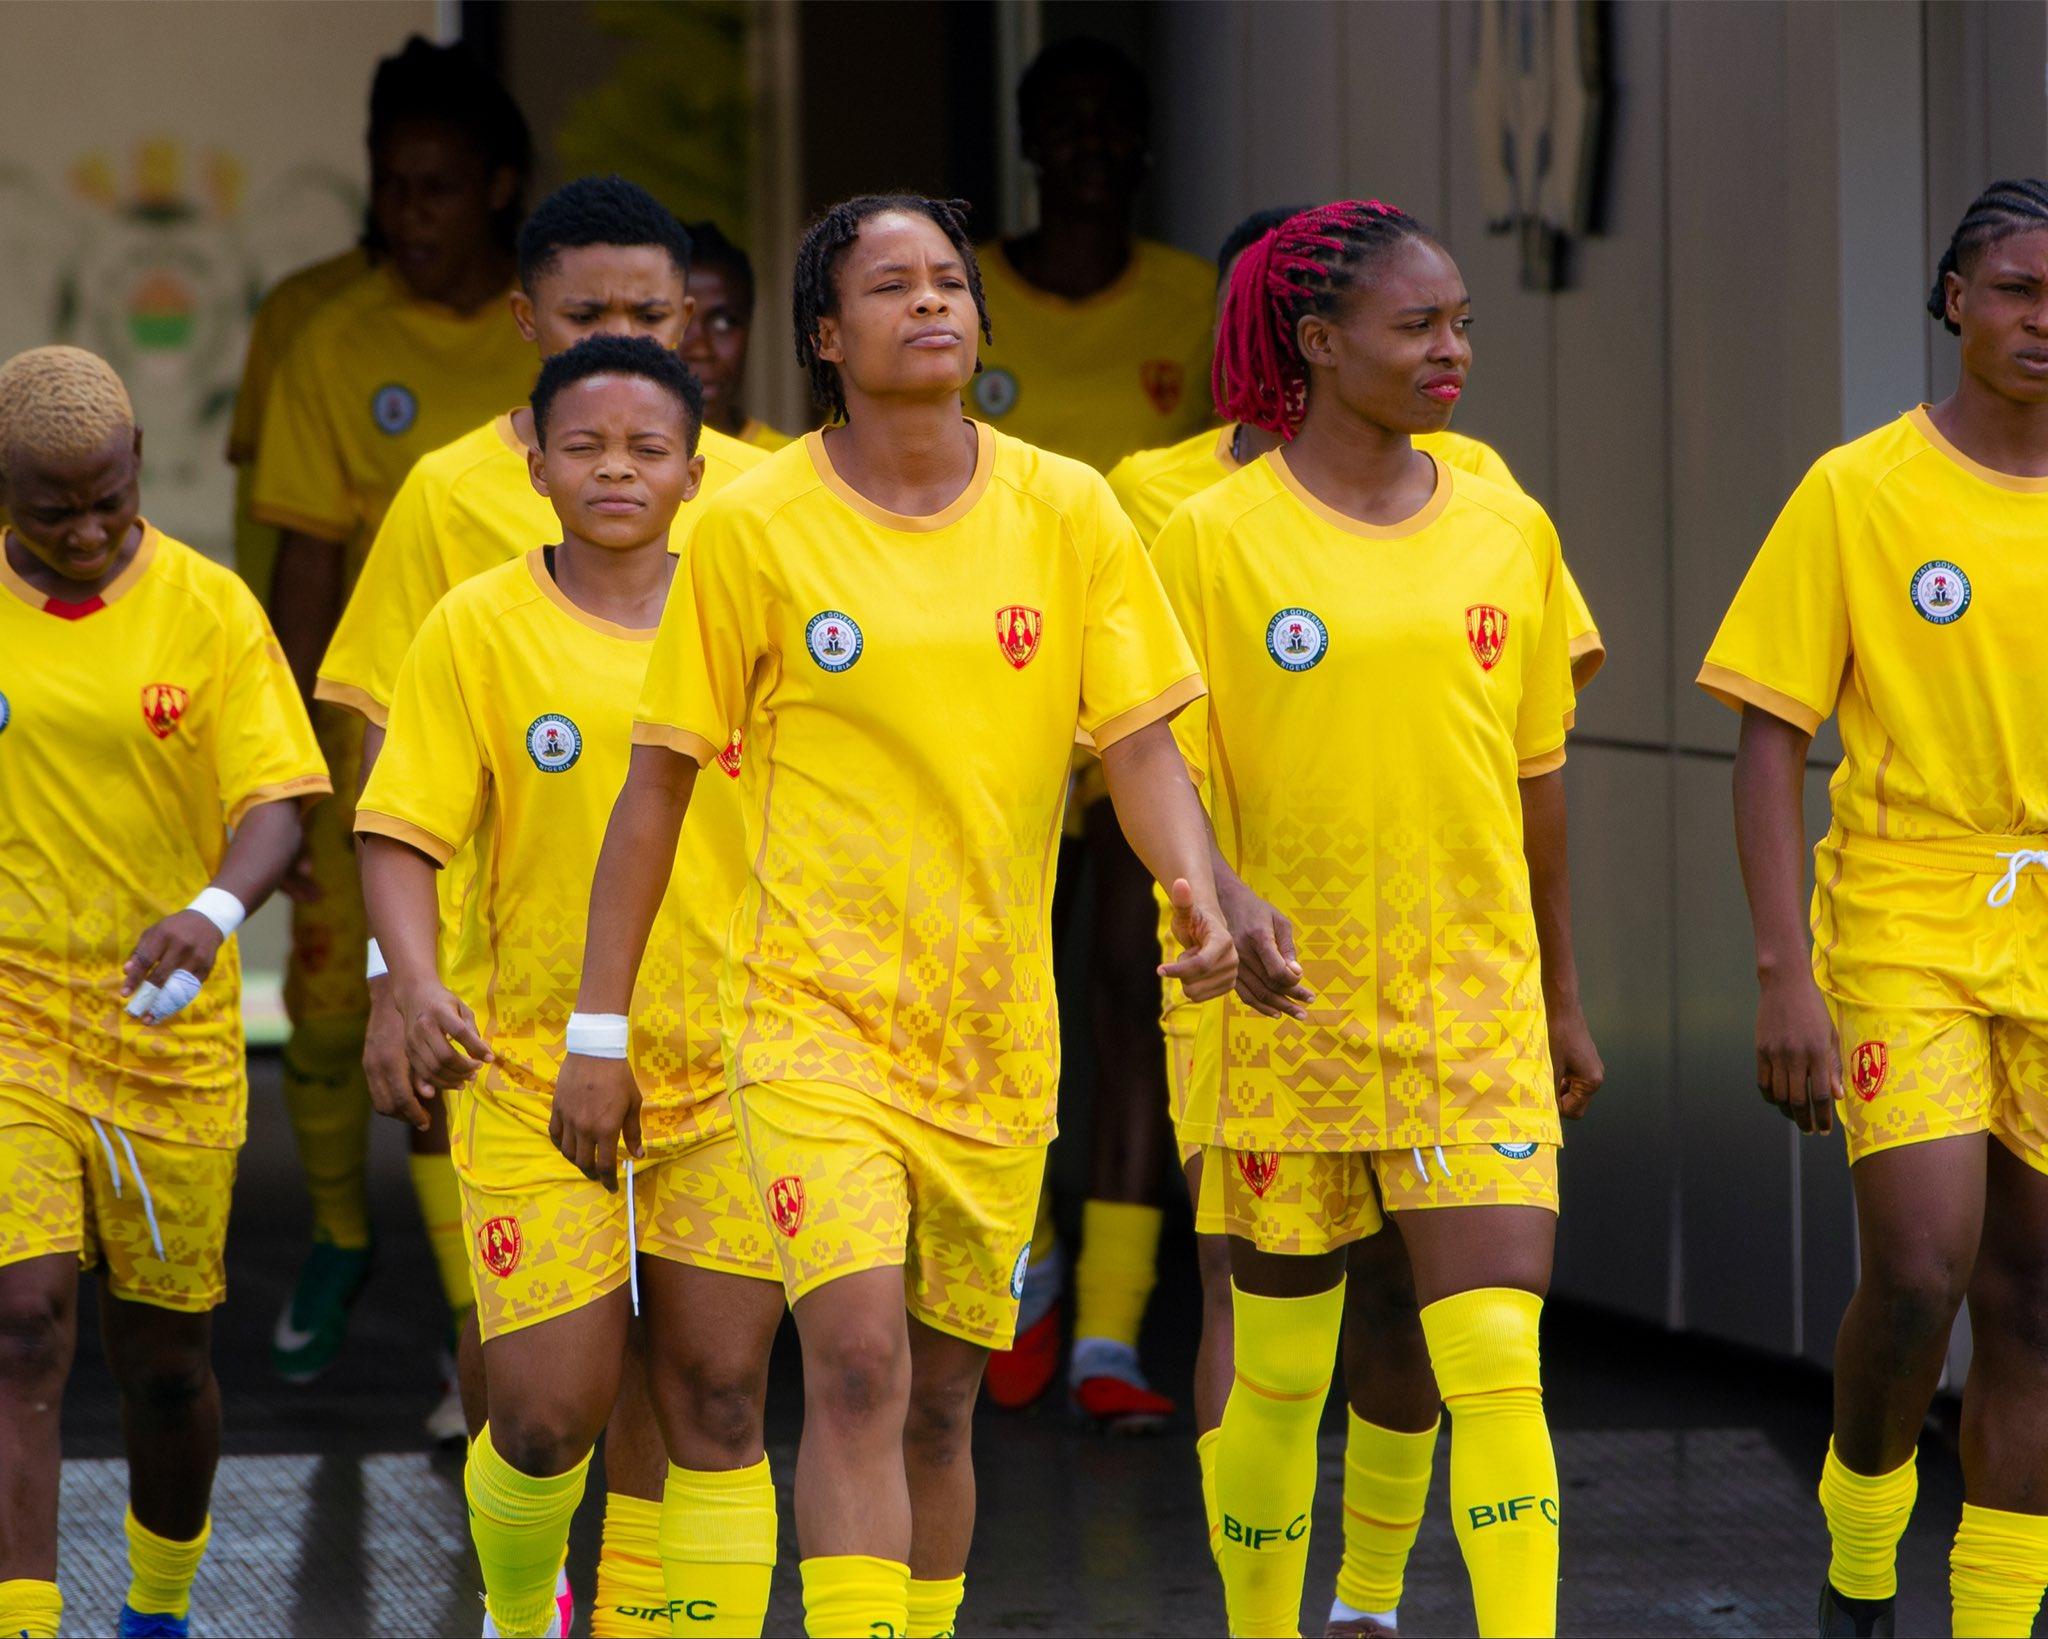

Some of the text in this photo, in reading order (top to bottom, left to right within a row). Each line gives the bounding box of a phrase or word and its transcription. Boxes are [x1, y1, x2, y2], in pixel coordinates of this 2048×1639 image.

[1914, 563, 1933, 582] STATE
[1935, 561, 1971, 600] GOVERNMENT
[1924, 613, 1960, 624] NIGERIA
[807, 613, 825, 631] STATE
[827, 611, 863, 649] GOVERNMENT
[1269, 611, 1288, 630] STATE
[1290, 609, 1327, 647] GOVERNMENT
[819, 660, 851, 672] NIGERIA
[1280, 660, 1316, 671] NIGERIA
[528, 716, 545, 734] STATE
[538, 762, 572, 772] NIGERIA
[1498, 1146, 1532, 1159] NIGERIA
[1468, 1495, 1558, 1530] BIFC
[1223, 1512, 1307, 1550] BIFC
